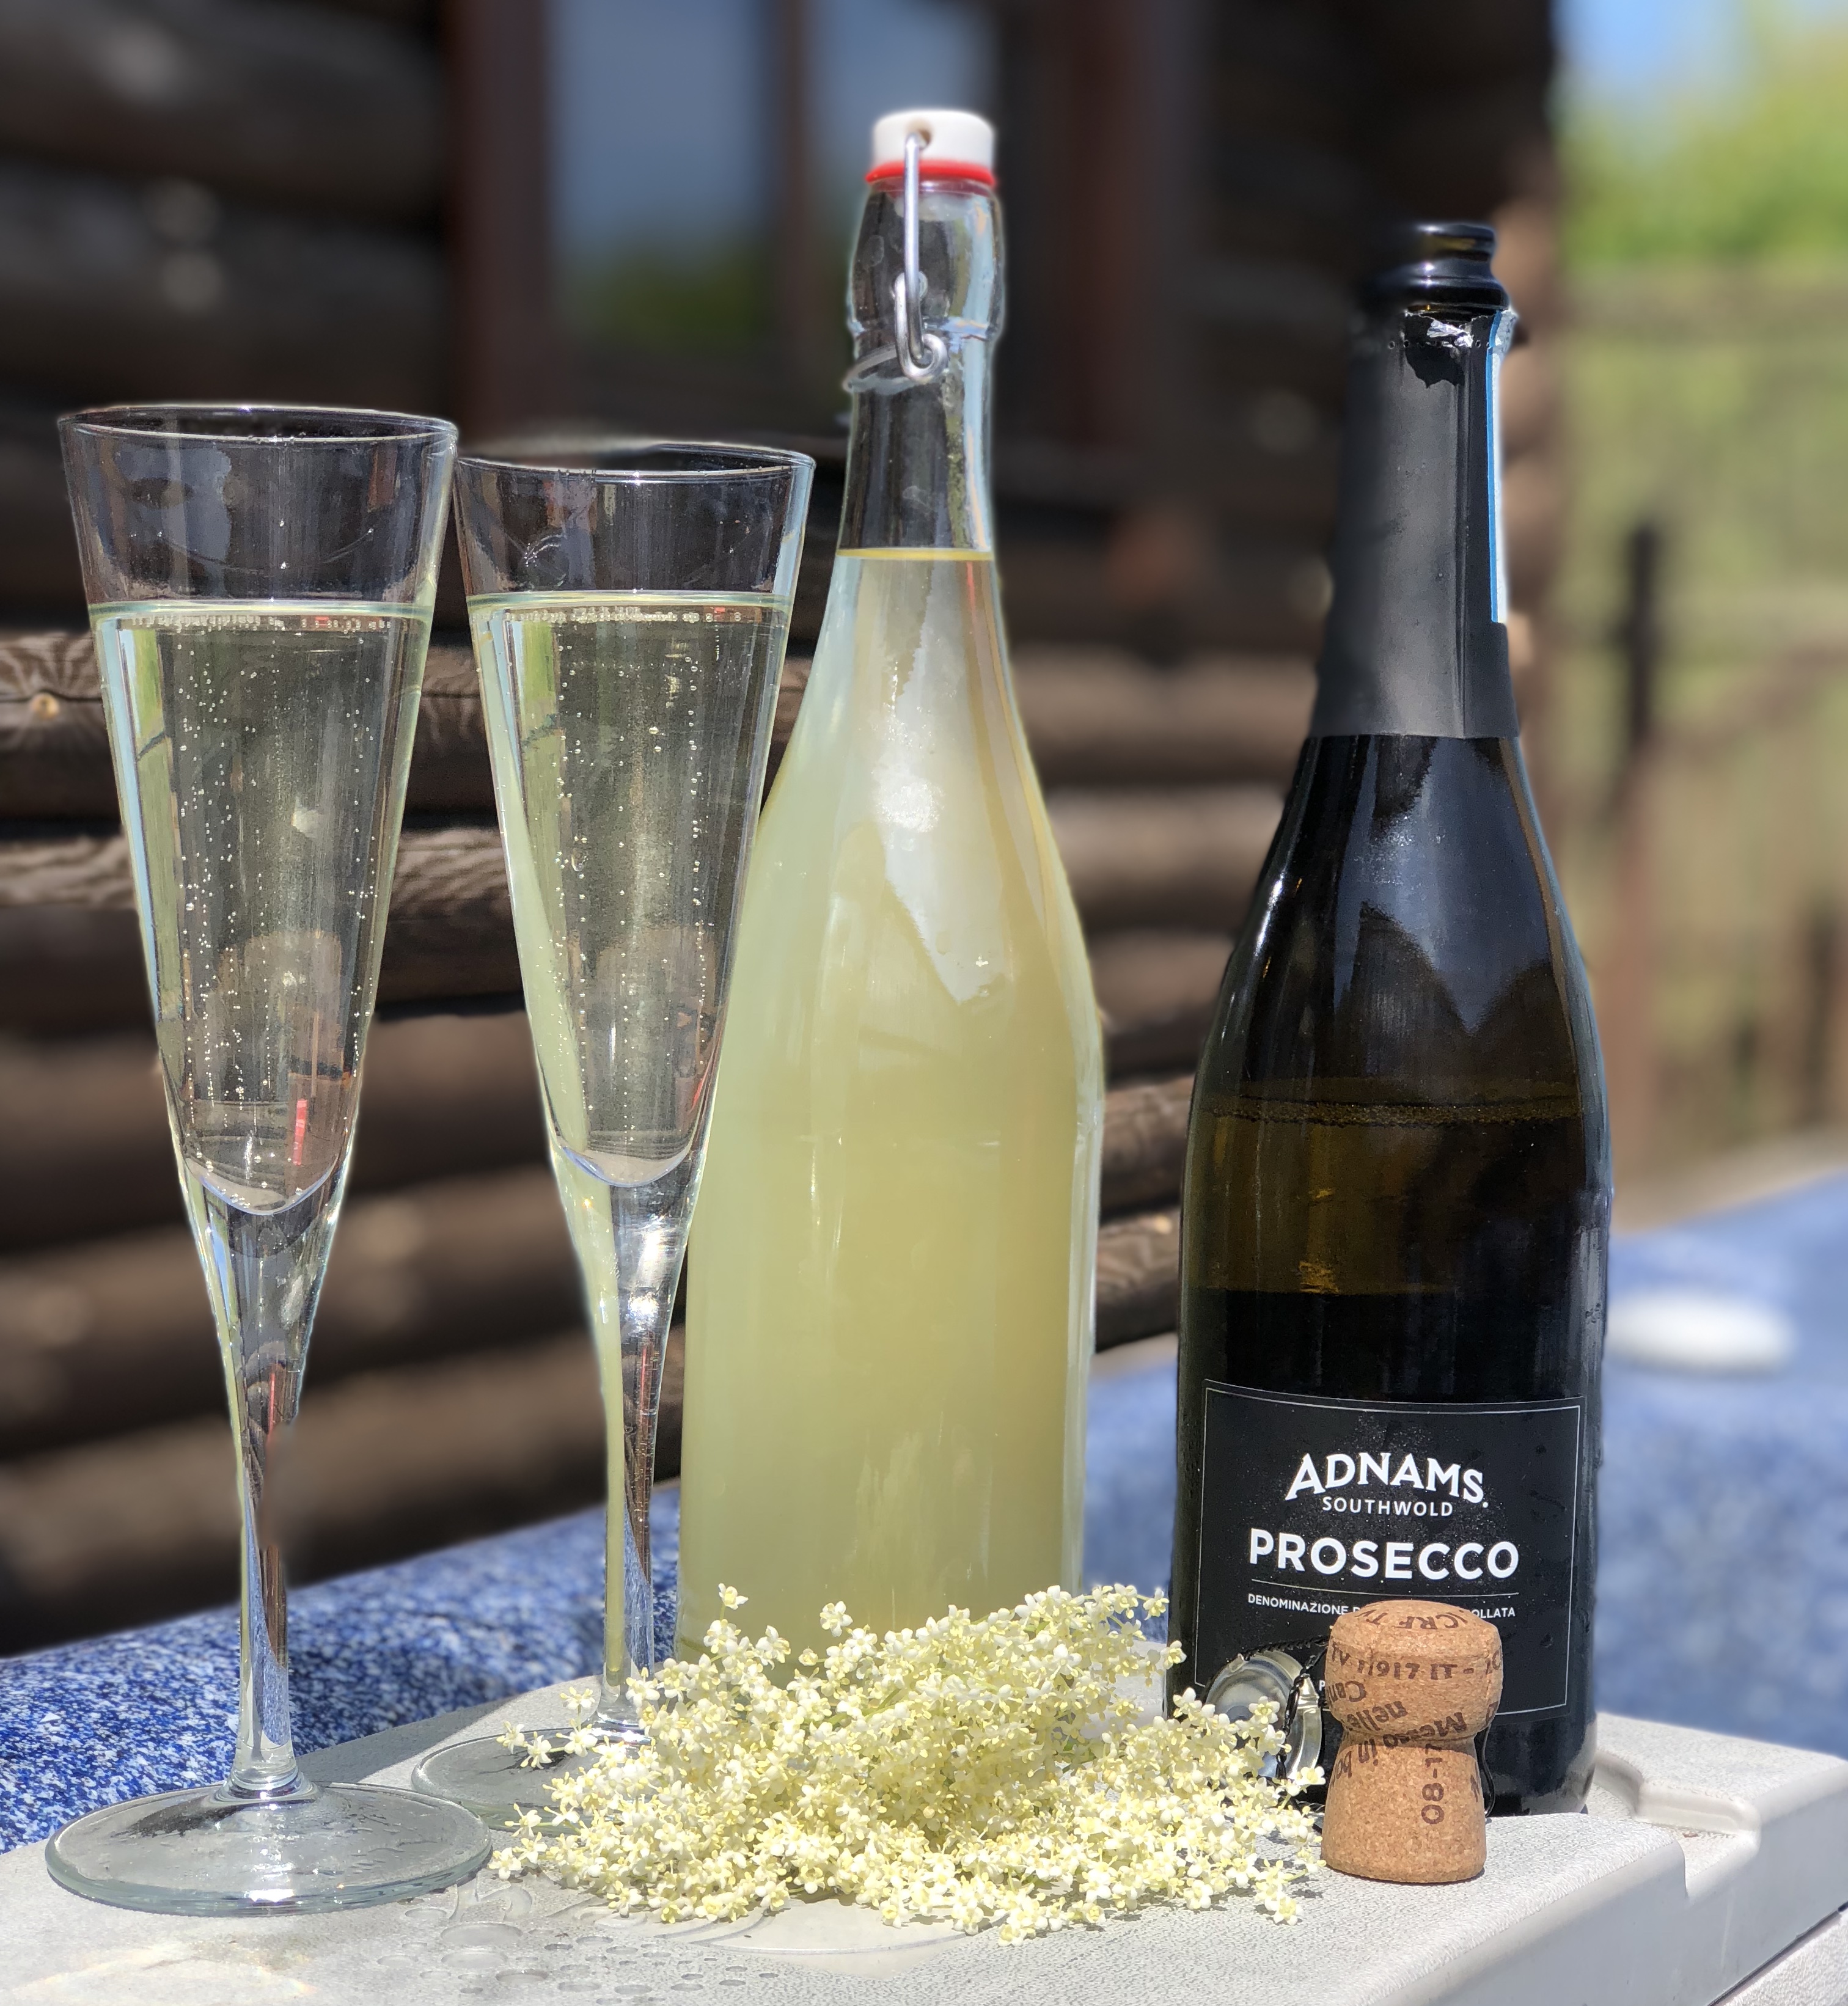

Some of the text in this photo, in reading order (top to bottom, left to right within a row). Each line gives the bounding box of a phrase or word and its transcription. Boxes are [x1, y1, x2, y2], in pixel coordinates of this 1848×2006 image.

[1322, 1495, 1454, 1517] SOUTHWOLD
[1249, 1528, 1519, 1580] PROSECCO
[1248, 1593, 1349, 1615] DENOMINAZIONE
[1471, 1606, 1516, 1619] OLLATA
